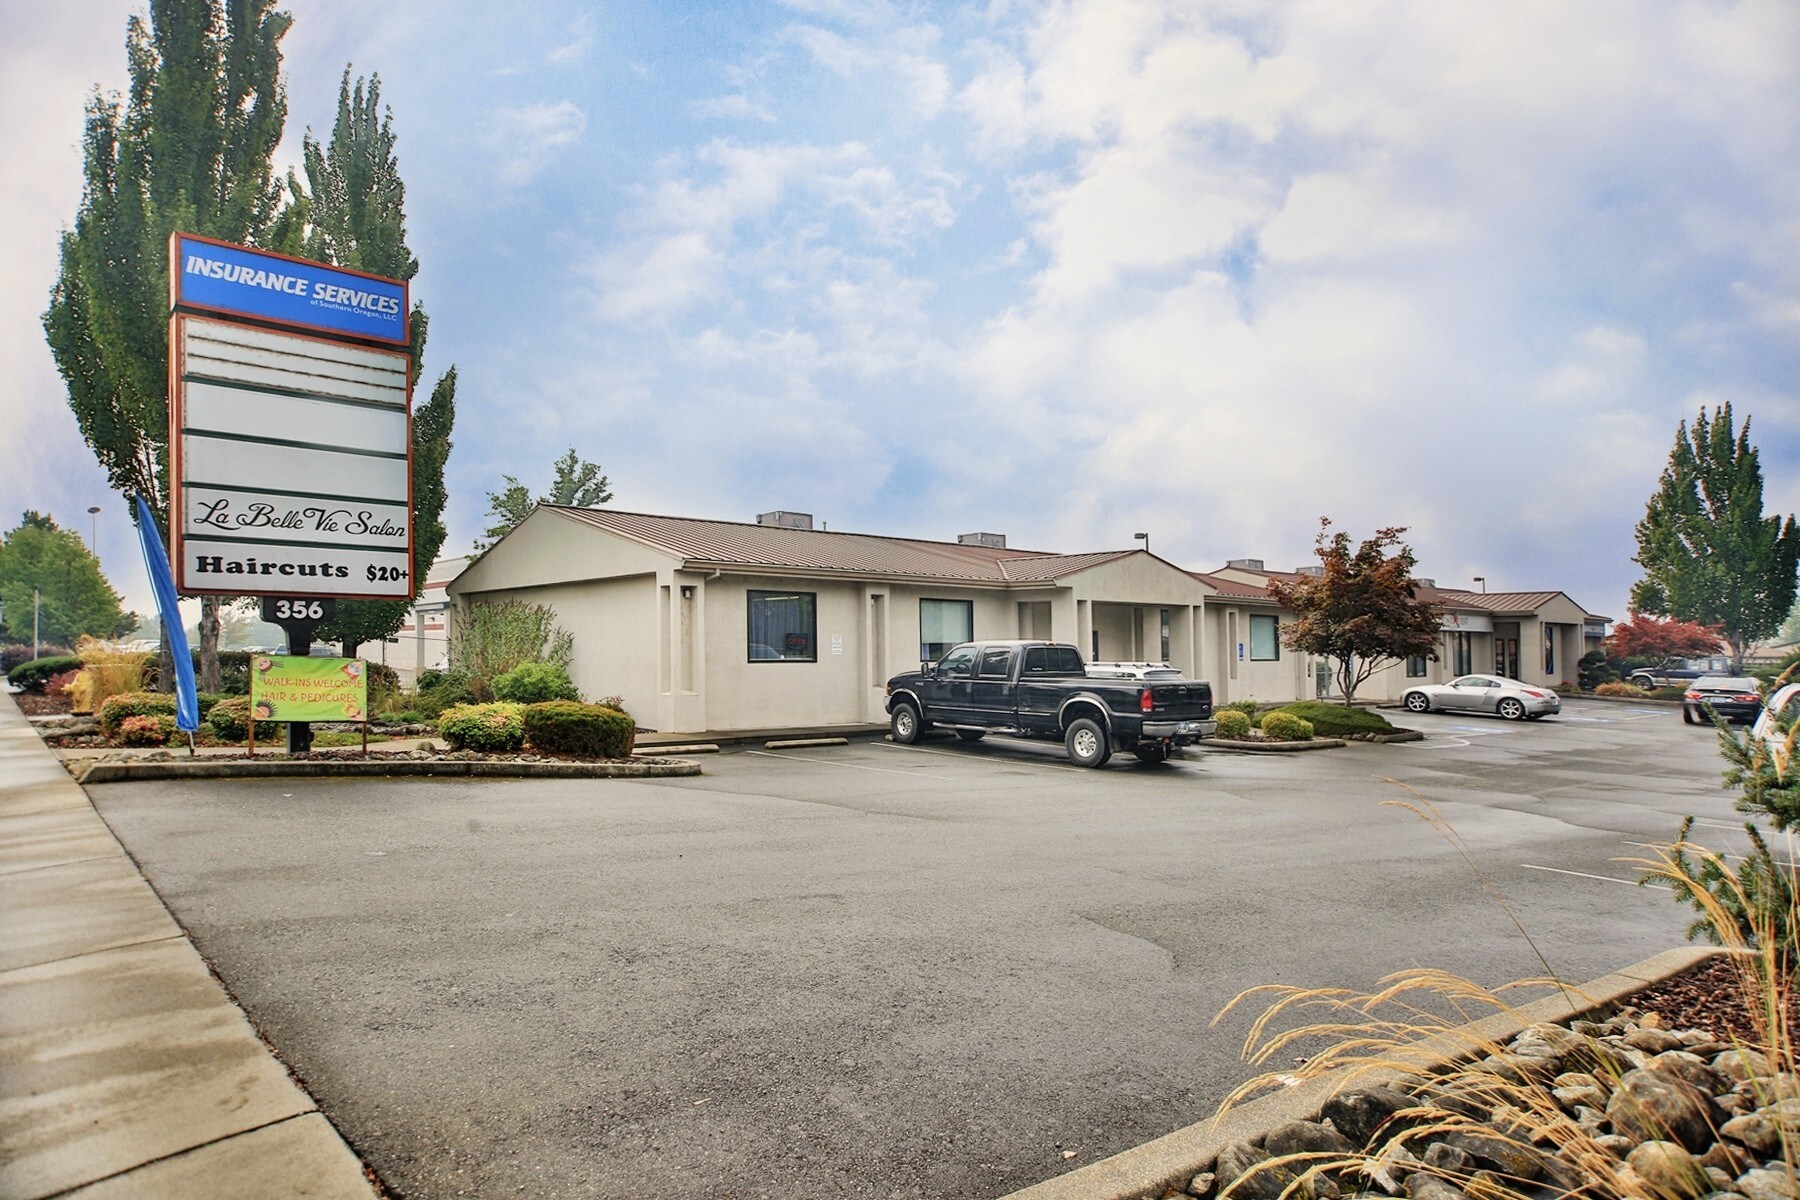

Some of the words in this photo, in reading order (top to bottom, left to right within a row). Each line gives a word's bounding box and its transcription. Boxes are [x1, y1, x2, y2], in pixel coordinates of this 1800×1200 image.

[186, 255, 309, 297] INSURANCE
[312, 283, 400, 315] SERVICES
[319, 300, 352, 312] Southern
[353, 307, 382, 319] Oregon,
[383, 313, 398, 321] LLC
[193, 499, 241, 531] La
[236, 502, 305, 529] Belle
[303, 507, 352, 532] Vie
[345, 510, 406, 537] Salon
[196, 555, 349, 578] Haircuts
[366, 563, 409, 583] $20+
[276, 600, 324, 620] 356
[263, 677, 311, 687] WALK-INS
[313, 679, 363, 689] WELCOME
[261, 691, 286, 701] HAIR
[289, 692, 298, 701] &
[301, 692, 359, 703] PEDICURES
